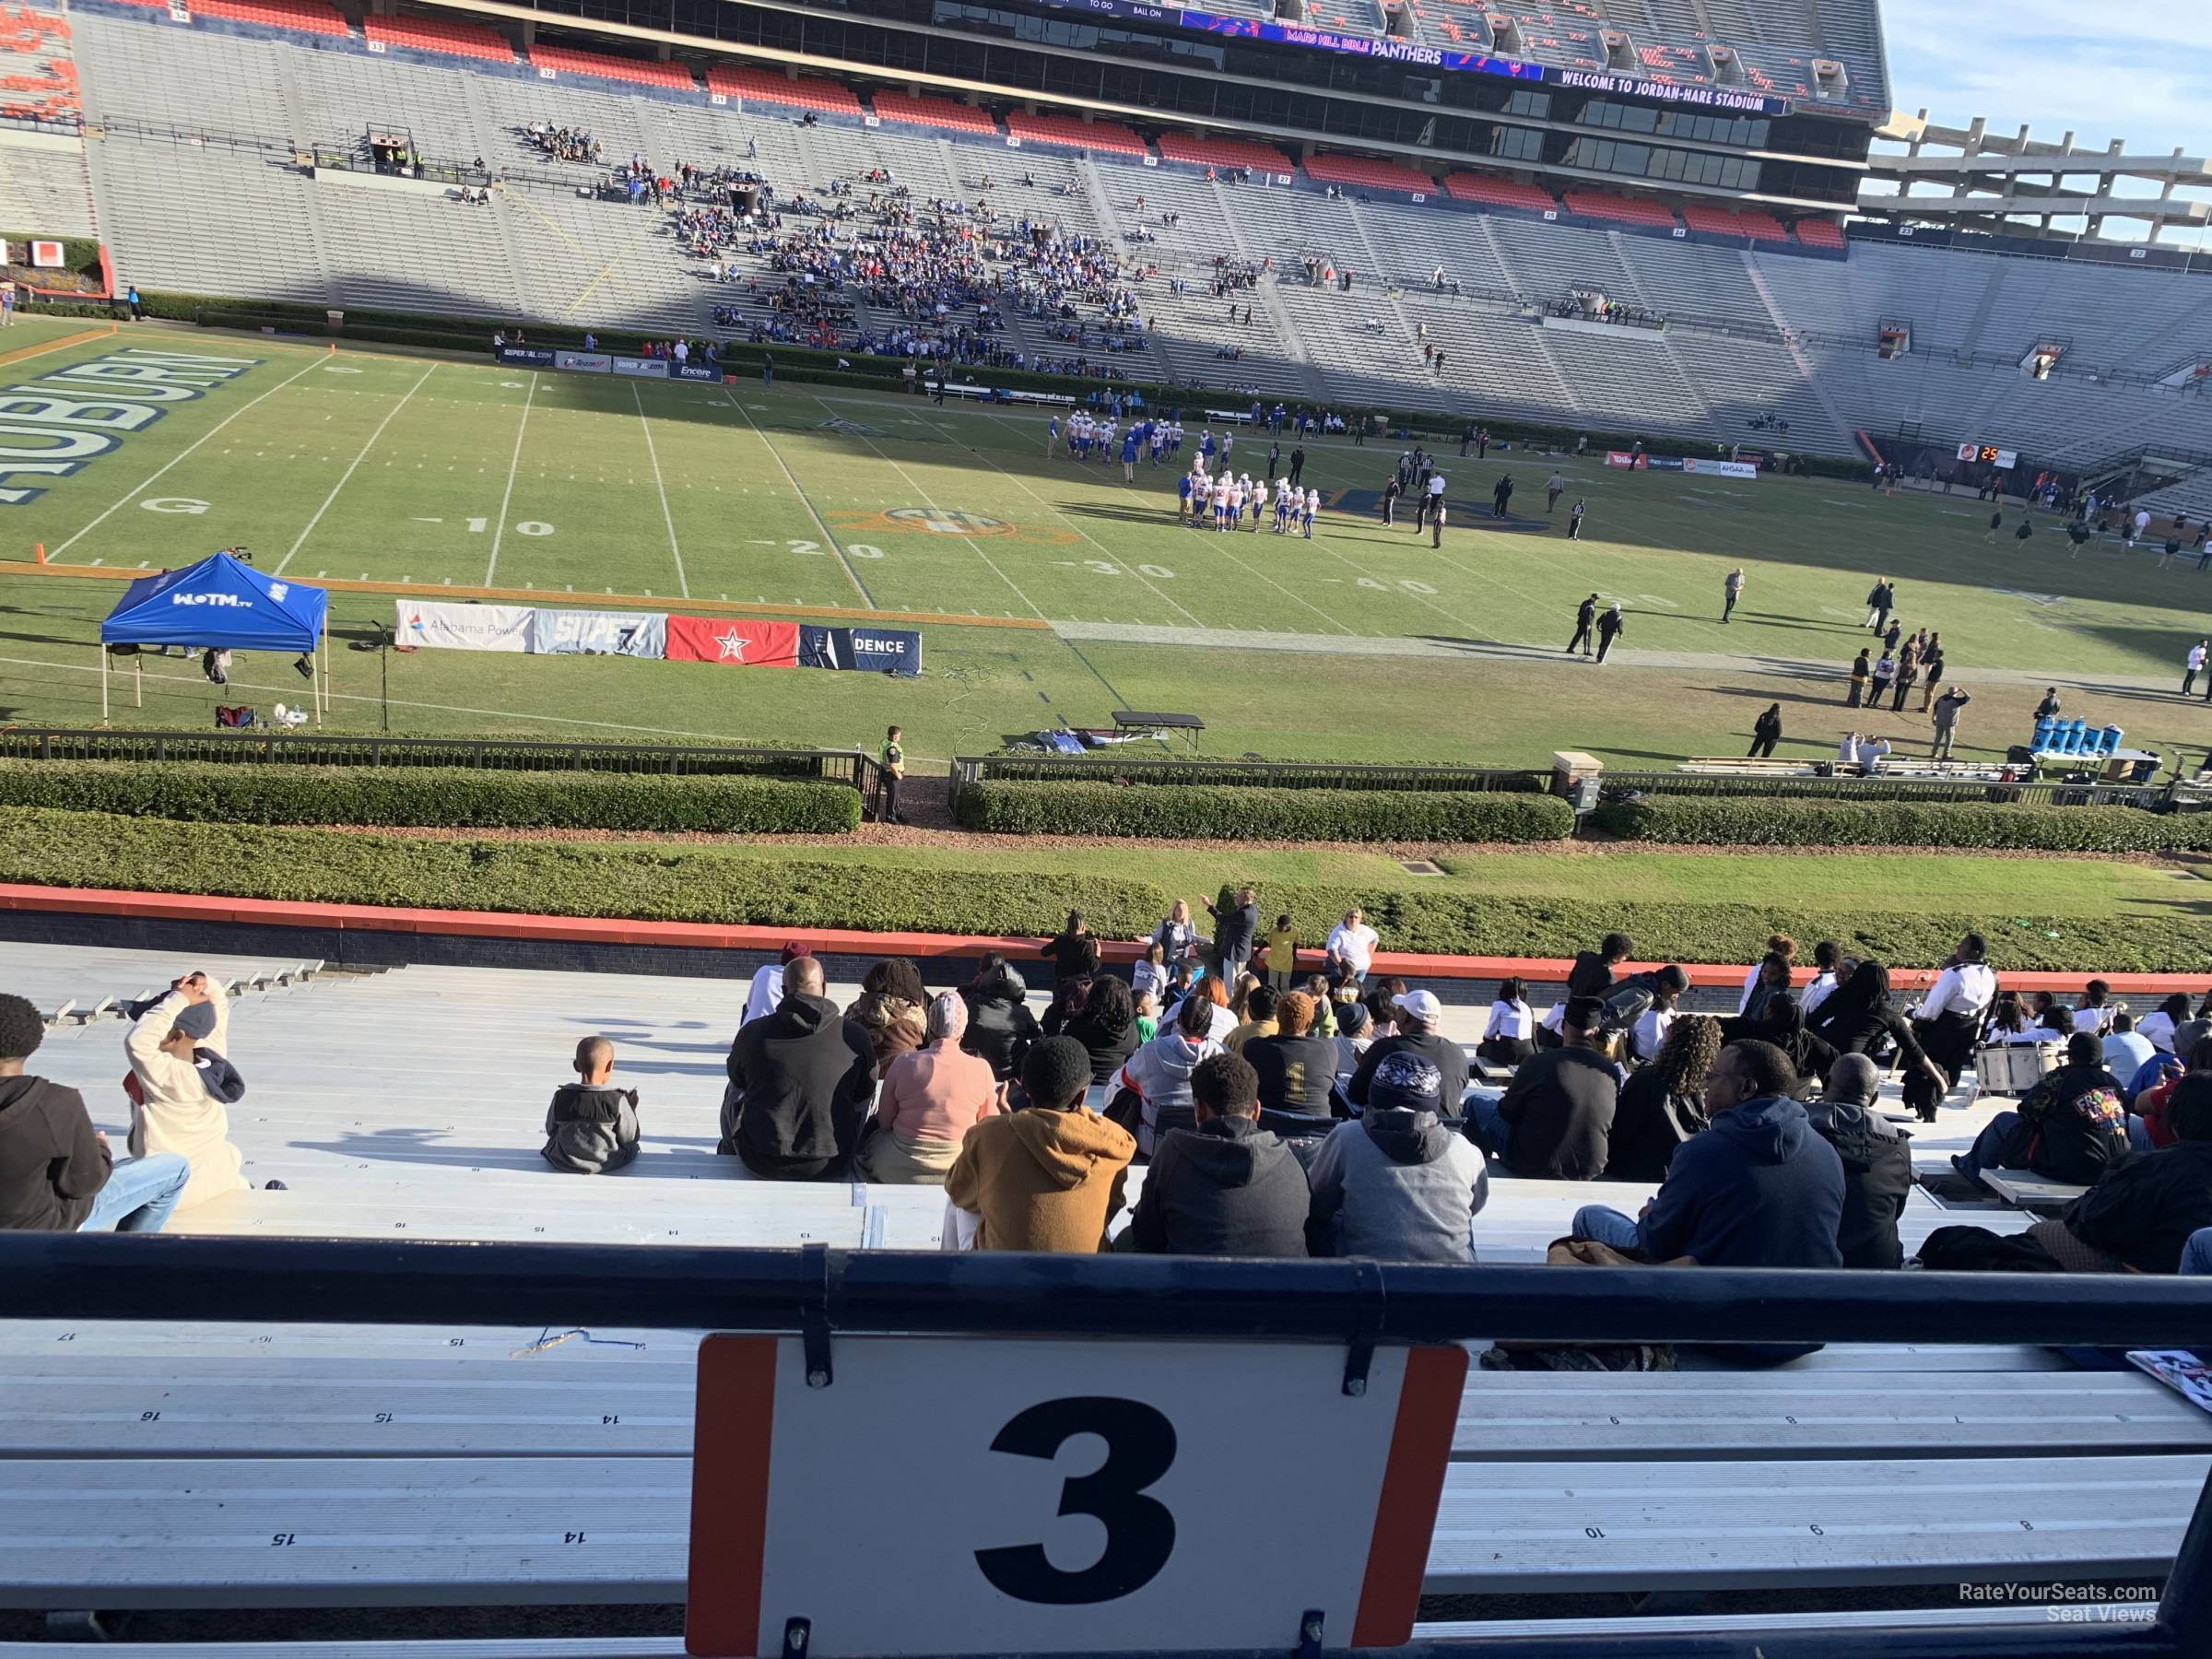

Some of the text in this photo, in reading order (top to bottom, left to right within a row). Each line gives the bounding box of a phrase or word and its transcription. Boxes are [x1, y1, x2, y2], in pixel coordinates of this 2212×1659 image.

[1100, 2, 1113, 10] GO
[1133, 6, 1162, 18] BALL ON
[1287, 29, 1442, 65] MARS HILL BIBLE PANTHERS
[1561, 71, 1764, 111] WELCOME TO JORDAN-HARE STADIUM
[680, 366, 712, 377] Encore
[1981, 446, 1997, 461] 25
[139, 497, 213, 514] G
[465, 518, 555, 536] 10
[786, 539, 885, 559] 20
[1083, 560, 1175, 579] 30
[430, 618, 525, 636] Alabama Power
[854, 638, 905, 653] DENCE
[1283, 1061, 1307, 1102] 1
[141, 1411, 160, 1421] 16
[374, 1412, 394, 1423] 15
[603, 1415, 619, 1424] 14
[1785, 1416, 1797, 1425] 8
[973, 1395, 1178, 1606] 3
[1584, 1526, 1606, 1539] 10
[2019, 1520, 2034, 1531] 8
[271, 1533, 296, 1547] 15
[564, 1532, 586, 1544] 14
